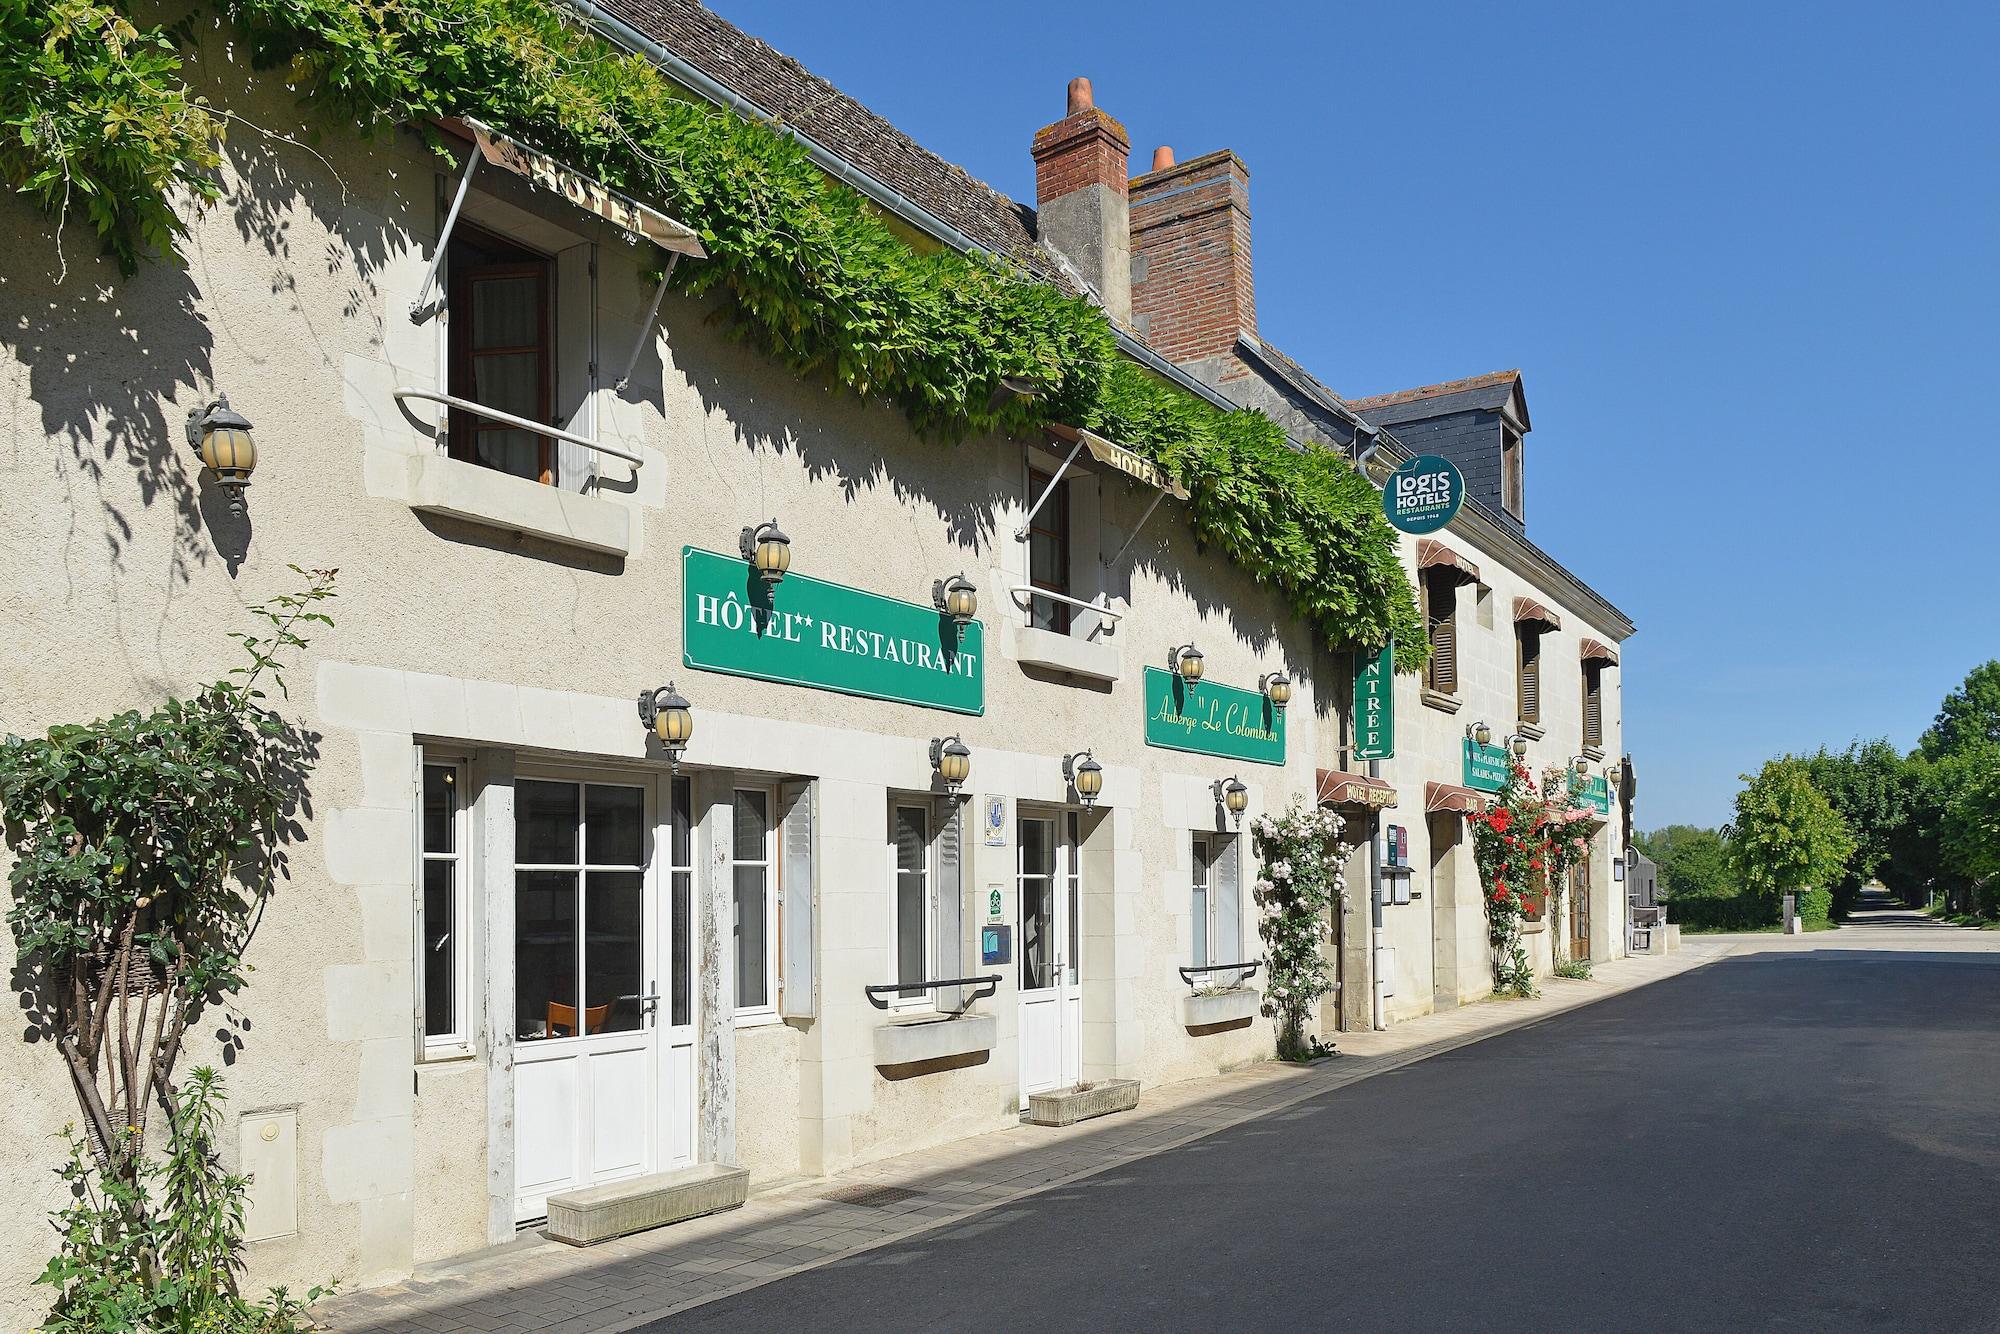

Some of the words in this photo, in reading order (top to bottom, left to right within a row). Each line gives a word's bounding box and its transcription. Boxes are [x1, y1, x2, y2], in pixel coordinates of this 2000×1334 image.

[1396, 490, 1451, 509] HOTELS
[1396, 502, 1450, 516] RESTAURANTS
[695, 591, 801, 643] HÔTEL
[819, 620, 977, 678] RESTAURANT
[1151, 694, 1198, 735] Auberge
[1346, 784, 1366, 801] HOTEL
